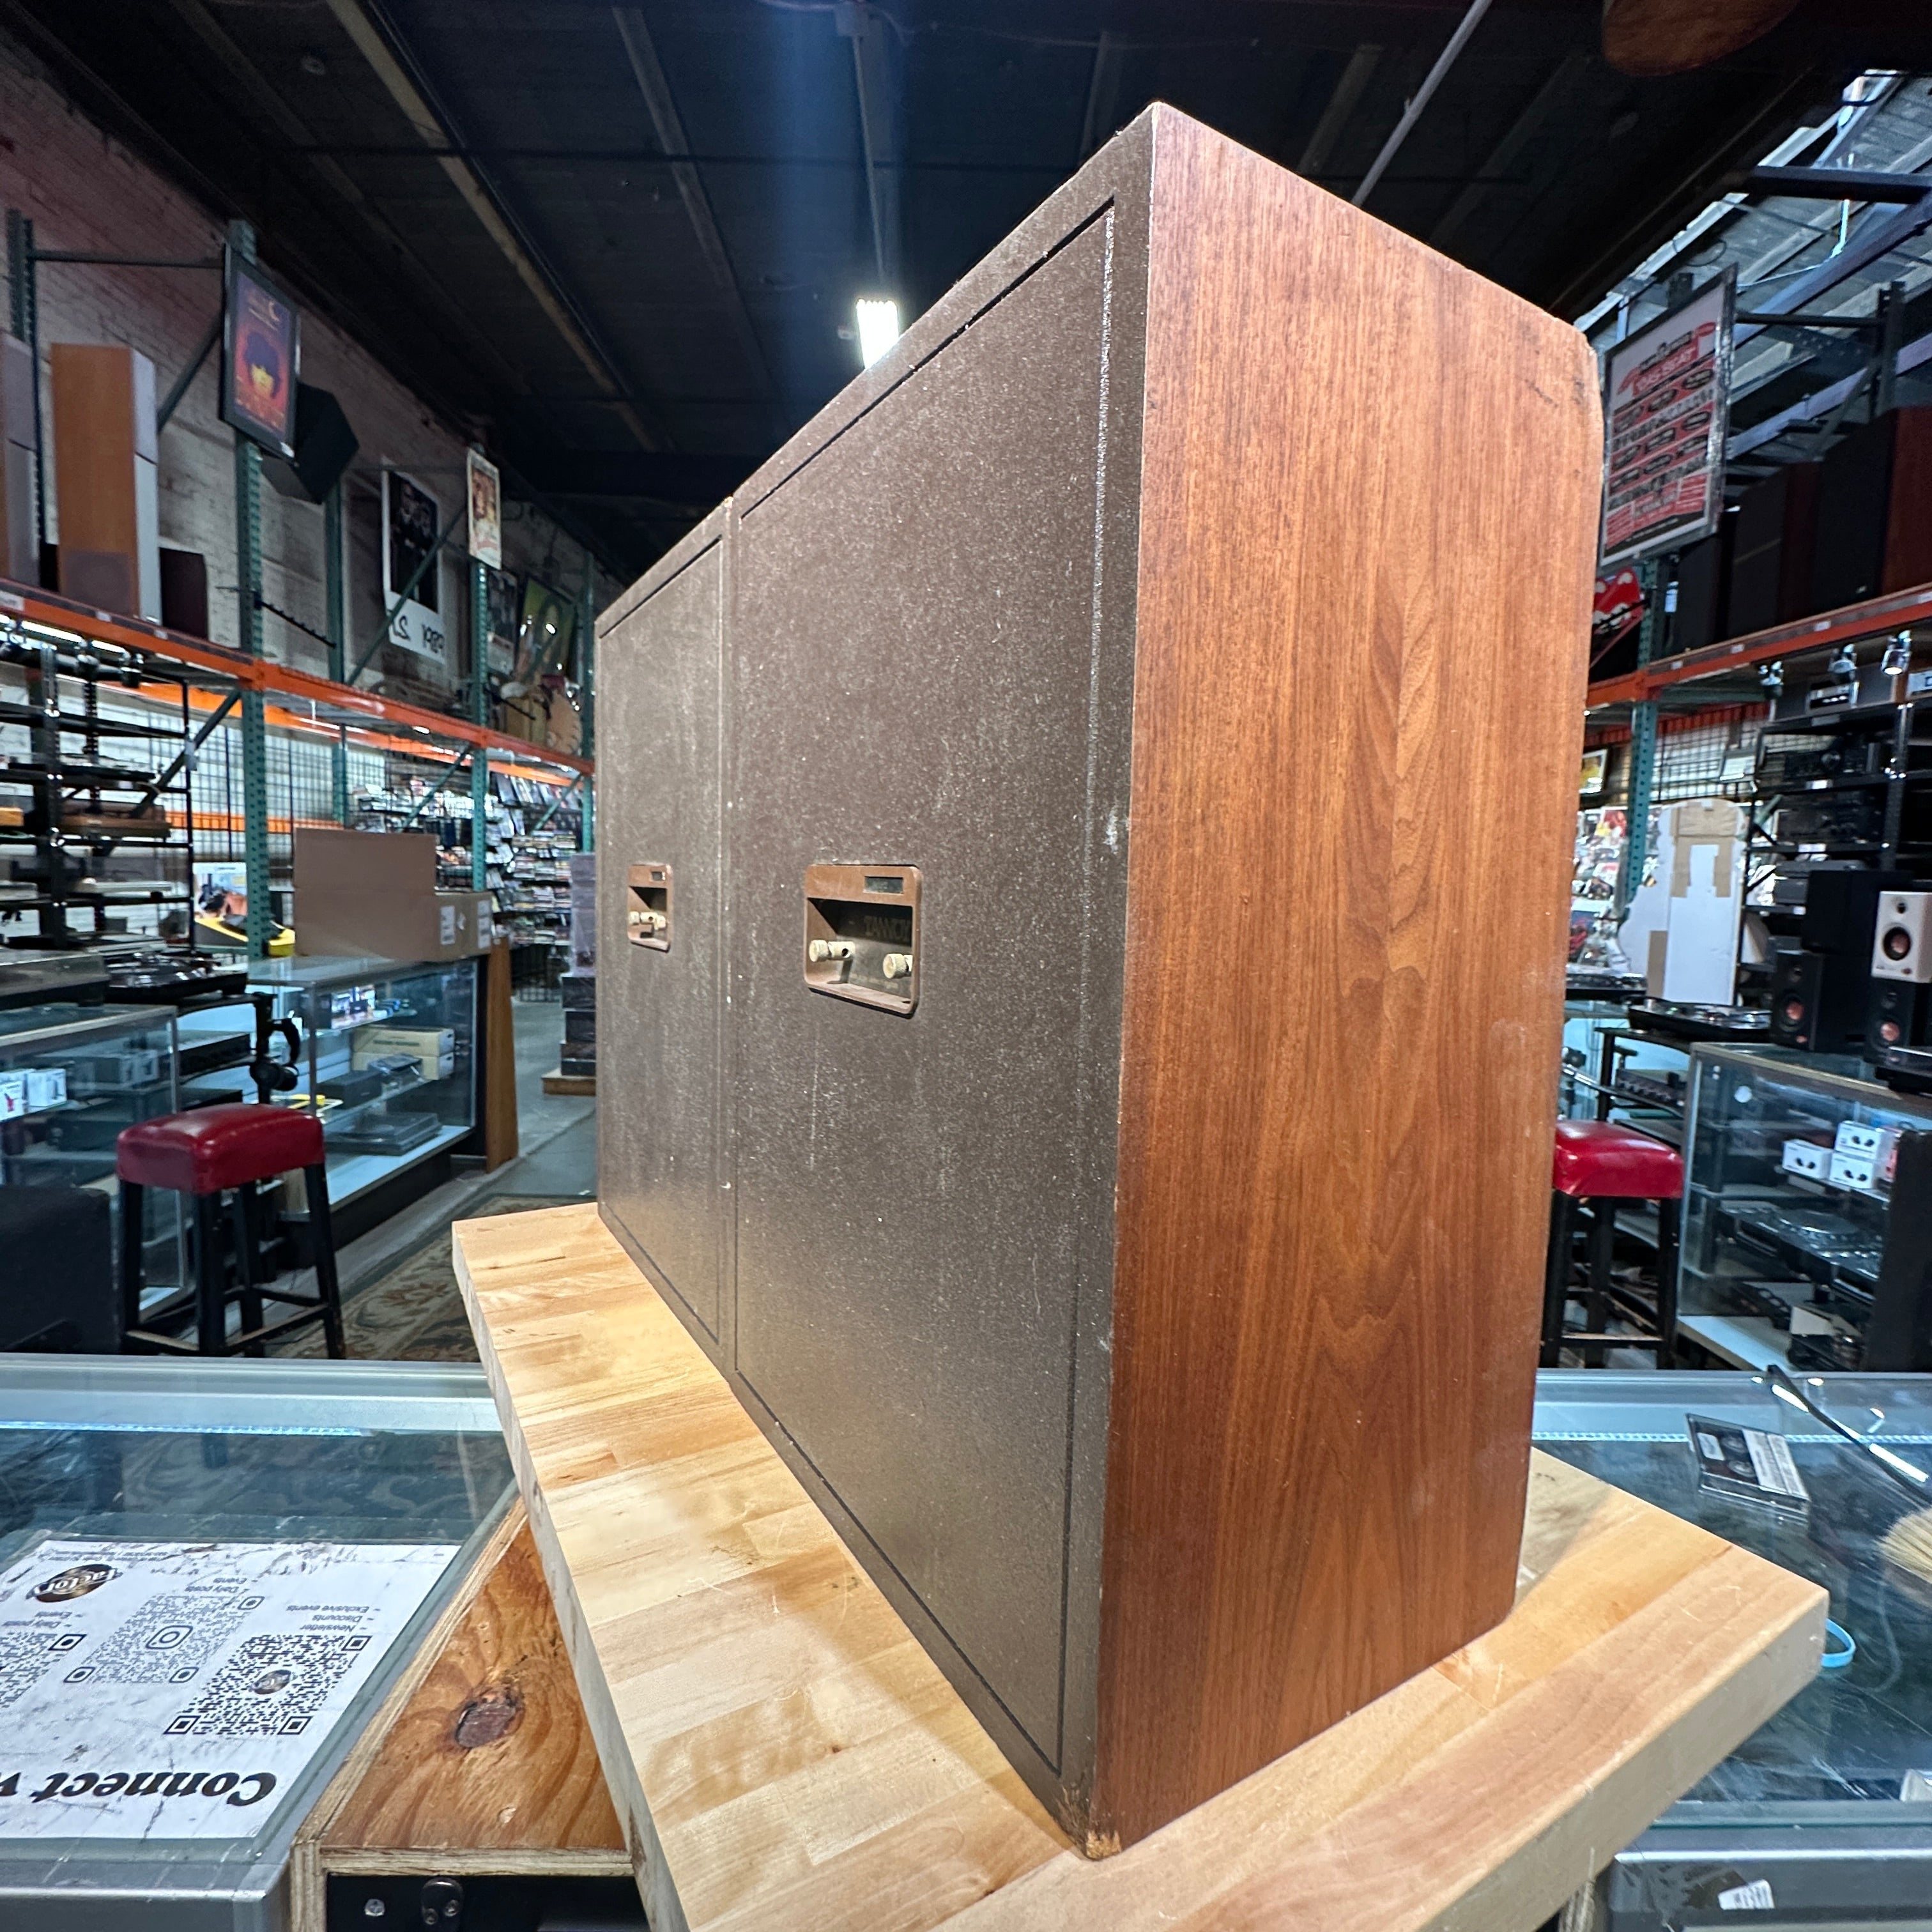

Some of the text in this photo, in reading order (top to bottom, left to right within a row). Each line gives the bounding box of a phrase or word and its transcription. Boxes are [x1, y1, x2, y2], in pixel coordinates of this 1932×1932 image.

[312, 1614, 363, 1623] Discounts
[299, 1624, 357, 1632] Newsletter
[30, 1772, 277, 1807] Connect
